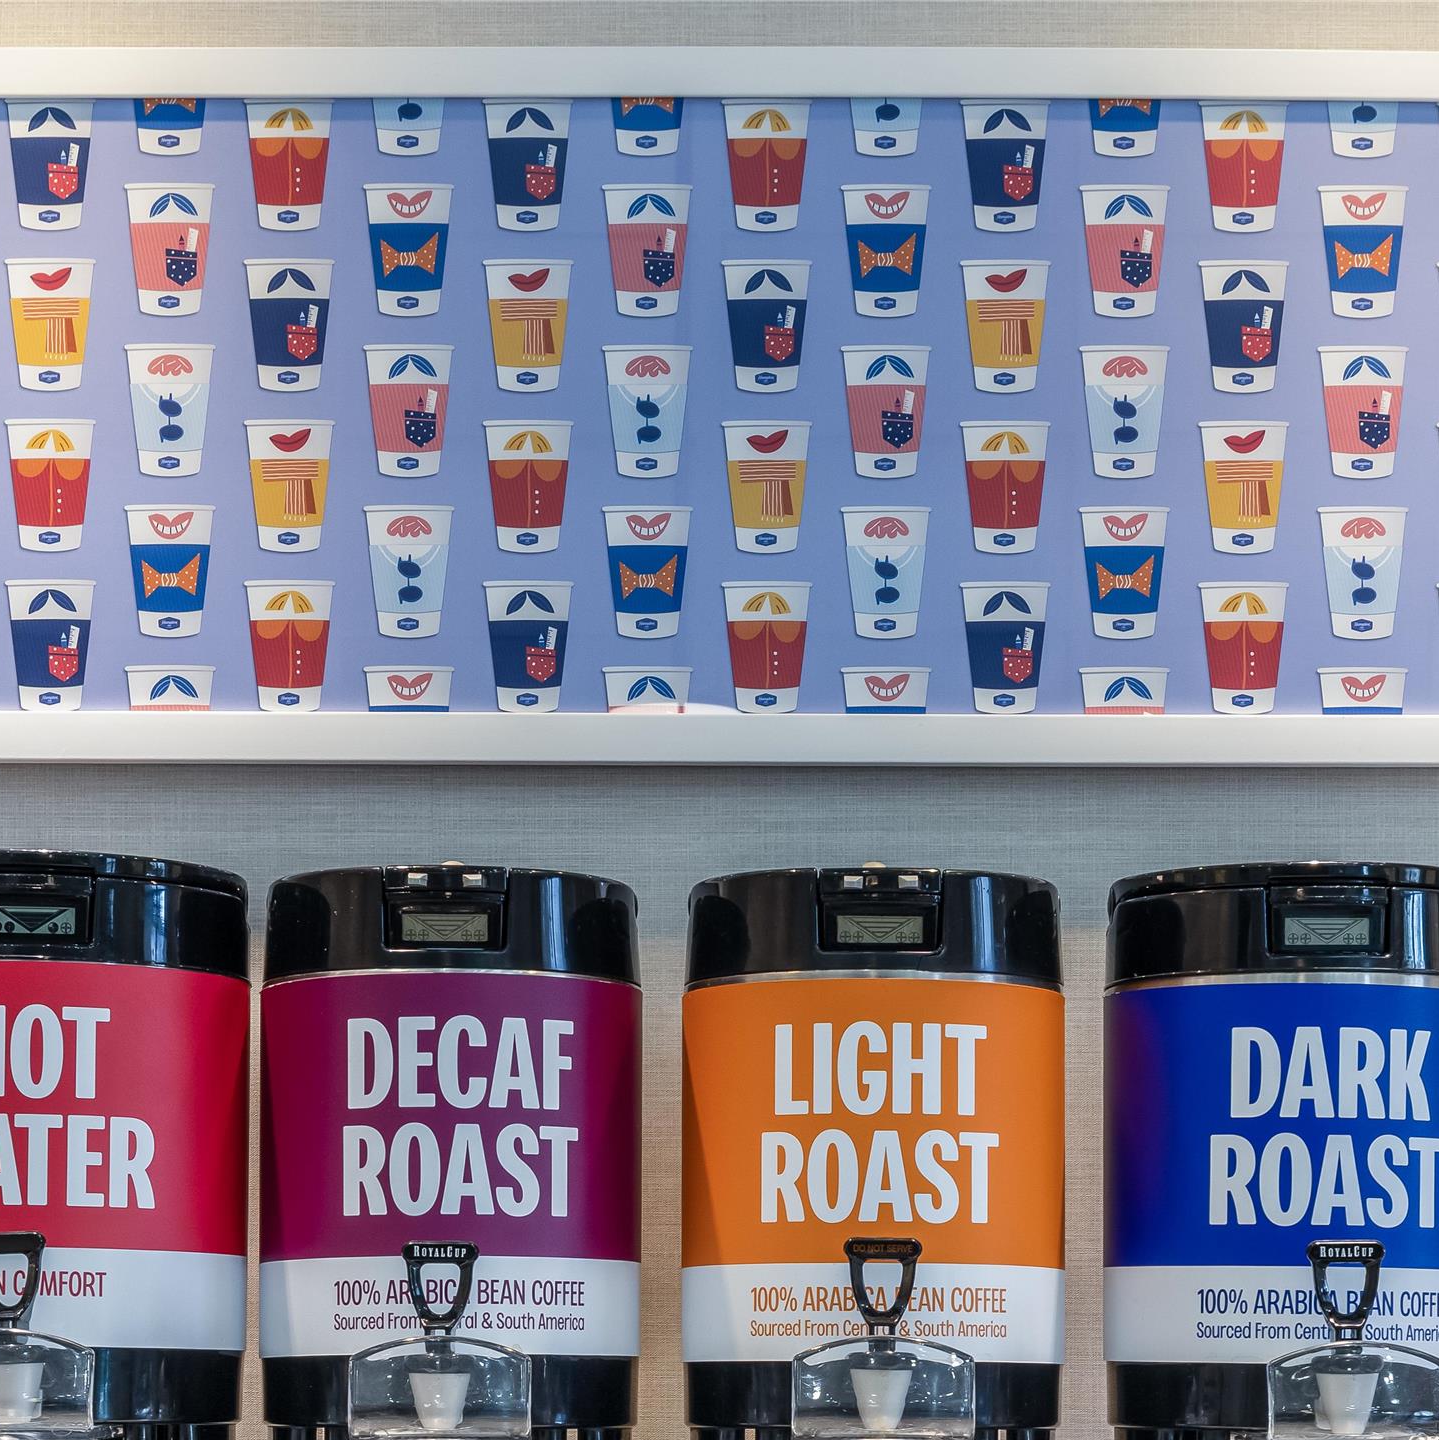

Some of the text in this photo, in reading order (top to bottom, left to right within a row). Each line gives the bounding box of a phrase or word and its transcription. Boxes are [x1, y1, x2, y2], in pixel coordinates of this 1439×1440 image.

[346, 1014, 576, 1111] DECAF
[773, 1019, 988, 1118] LIGHT
[1230, 1026, 1430, 1122] DARK
[343, 1122, 580, 1219] ROAST
[760, 1129, 1000, 1225] ROAST
[852, 1244, 914, 1253] DO NOT SERVE
[13, 1270, 107, 1297] CMFORT
[333, 1279, 585, 1306] 100% ARBIC BEAN COFFEE
[750, 1286, 1007, 1314] 100% ARABA EAN COFFEE
[1197, 1288, 1248, 1315] 100%
[333, 1312, 424, 1331] Sourced From
[481, 1313, 493, 1330] &
[496, 1312, 535, 1331] South
[538, 1313, 585, 1332] America
[750, 1319, 801, 1337] Sourced
[804, 1319, 839, 1337] From
[899, 1319, 911, 1337] &
[914, 1320, 954, 1338] South
[958, 1320, 1007, 1338] America
[1196, 1321, 1252, 1340] Sourced
[1255, 1322, 1291, 1340] From
[1365, 1324, 1403, 1341] South
